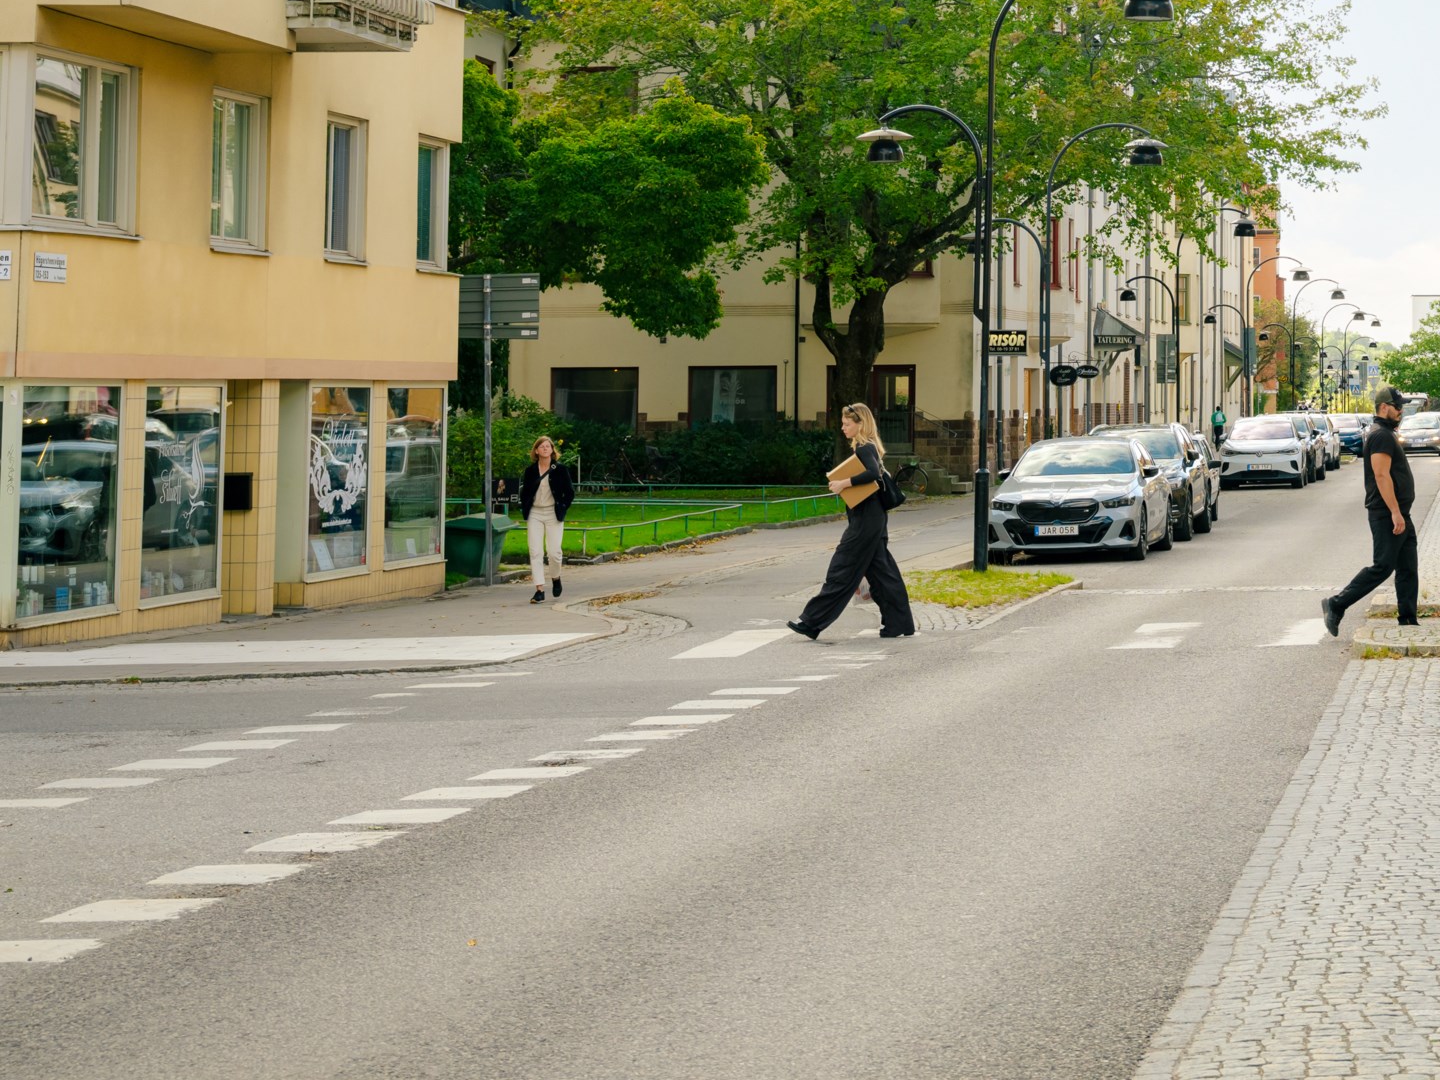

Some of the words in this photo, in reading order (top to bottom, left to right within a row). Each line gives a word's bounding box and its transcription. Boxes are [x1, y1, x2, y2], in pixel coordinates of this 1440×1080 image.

[989, 331, 1026, 347] RISÖR
[1098, 336, 1133, 344] TATUERING
[1042, 526, 1056, 534] JAR
